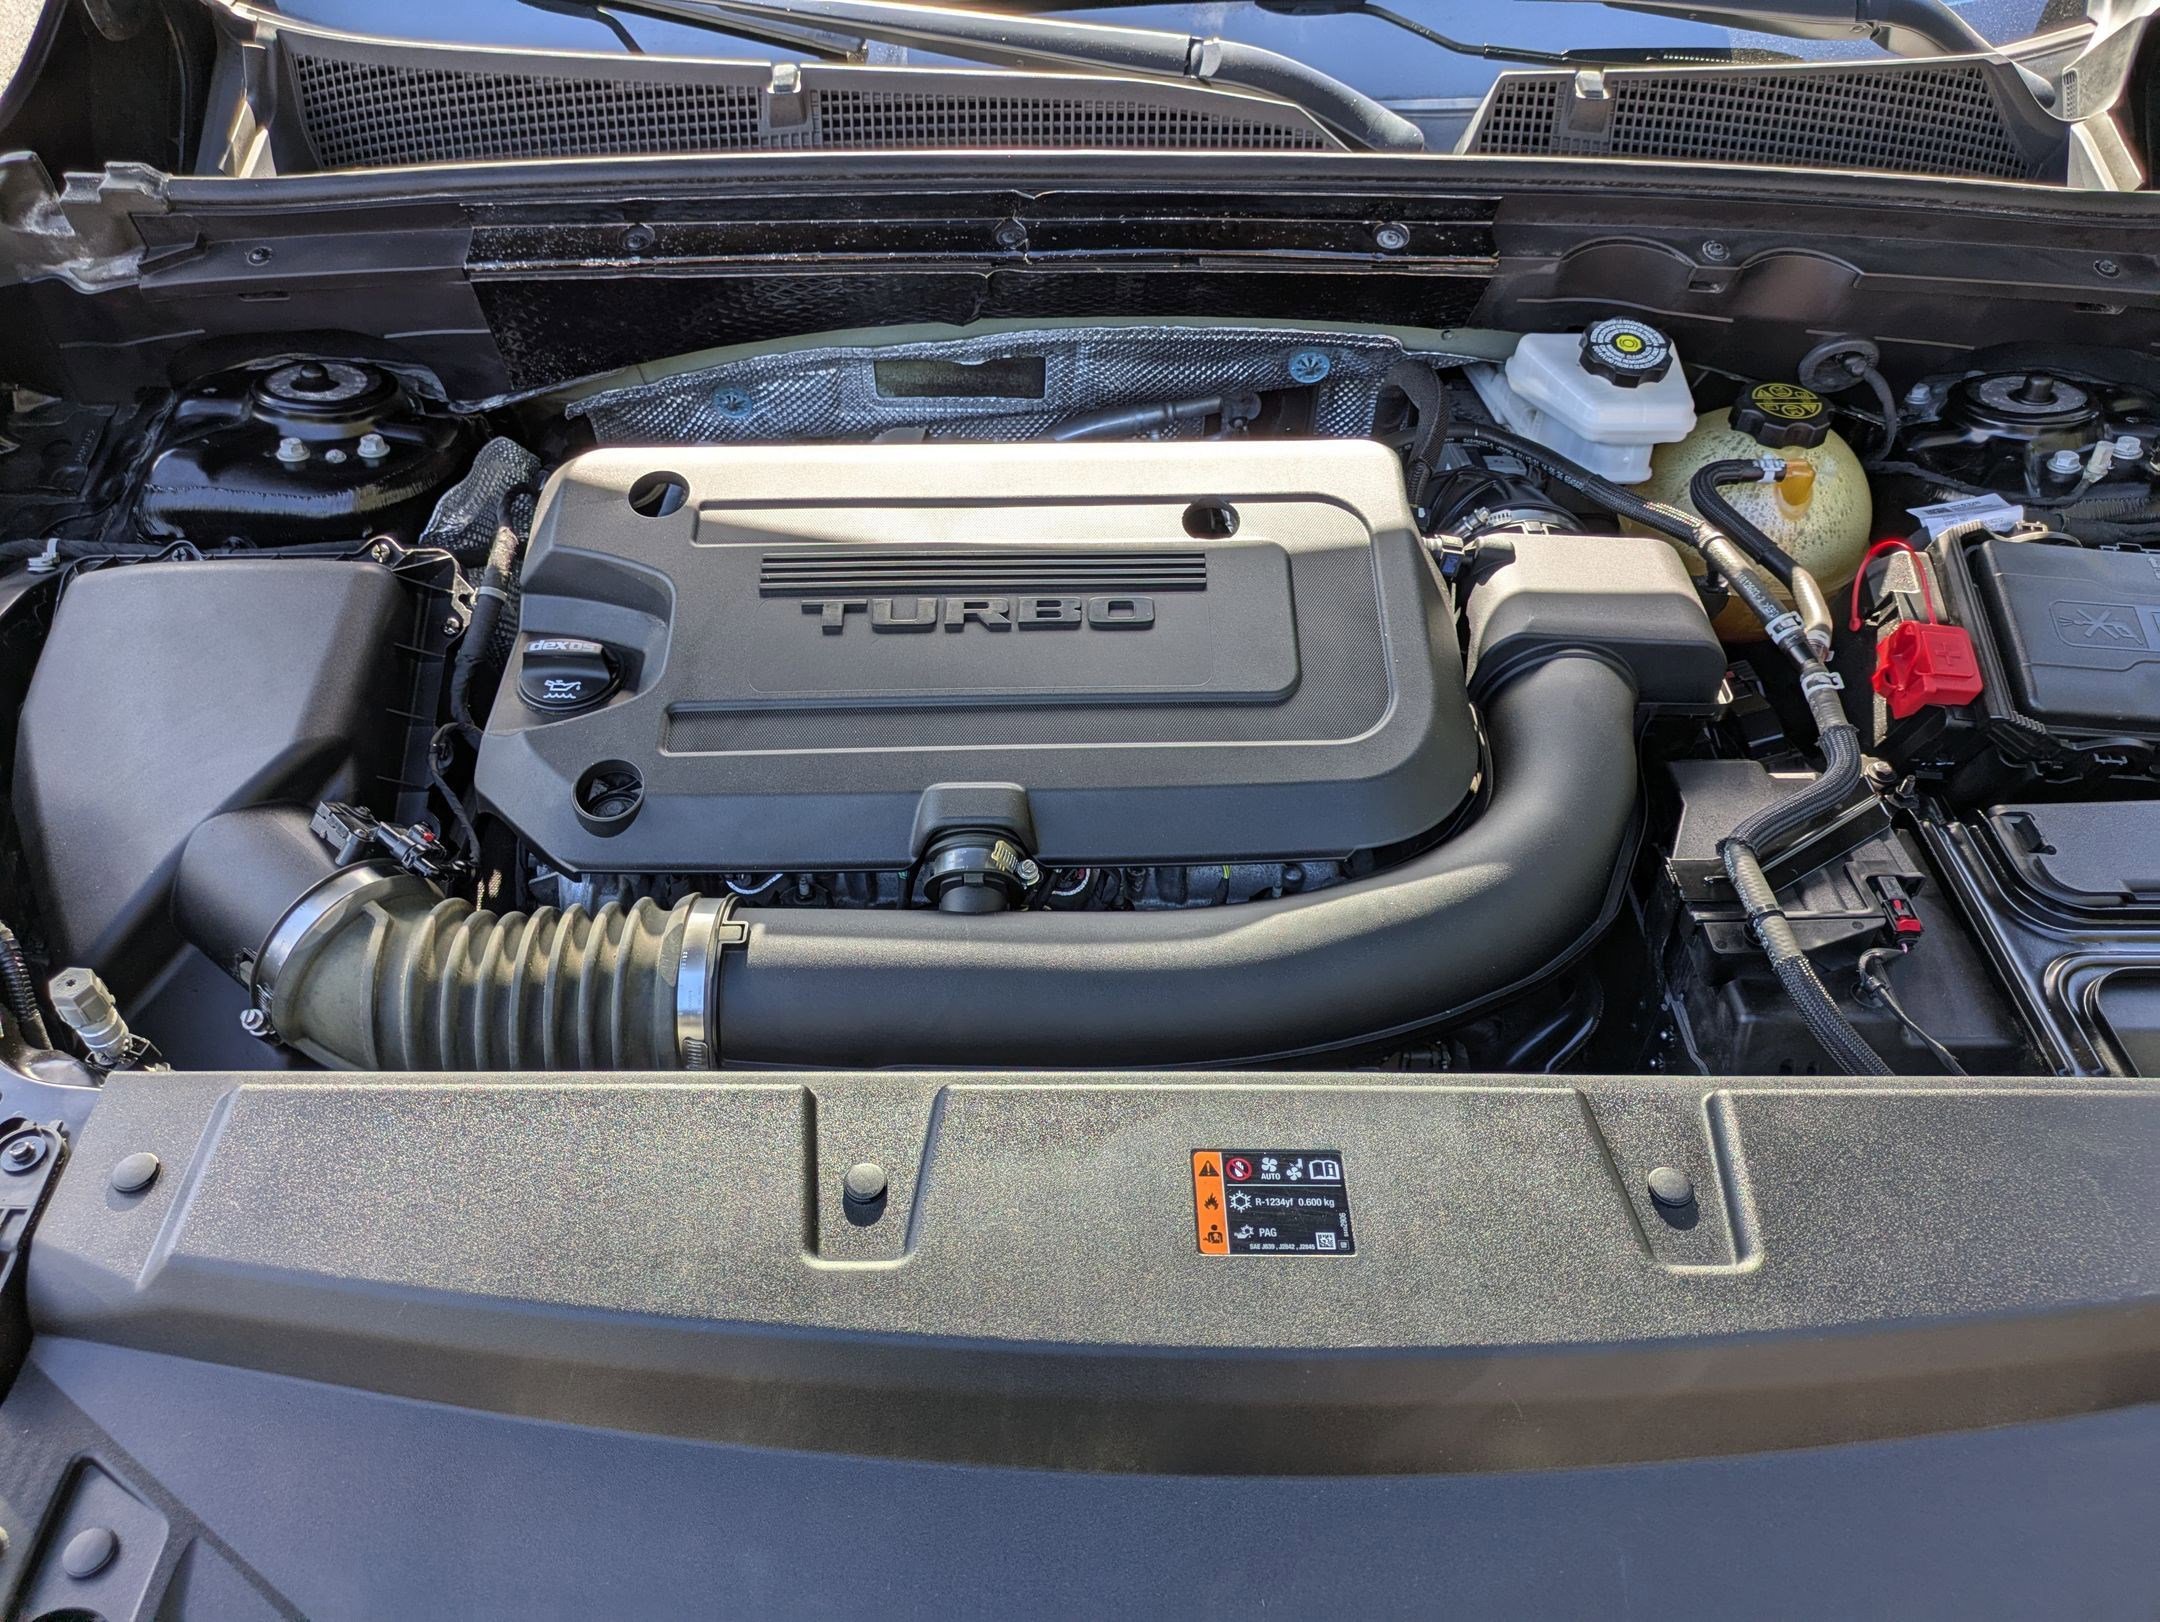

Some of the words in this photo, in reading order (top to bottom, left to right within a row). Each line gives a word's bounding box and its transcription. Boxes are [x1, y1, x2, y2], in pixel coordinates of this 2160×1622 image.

[801, 597, 1156, 634] TURBO
[529, 640, 595, 651] dexos
[1255, 1197, 1294, 1208] R-1234yf
[1298, 1197, 1322, 1207] 0.600
[1324, 1197, 1335, 1208] kg
[1259, 1228, 1277, 1237] PAG
